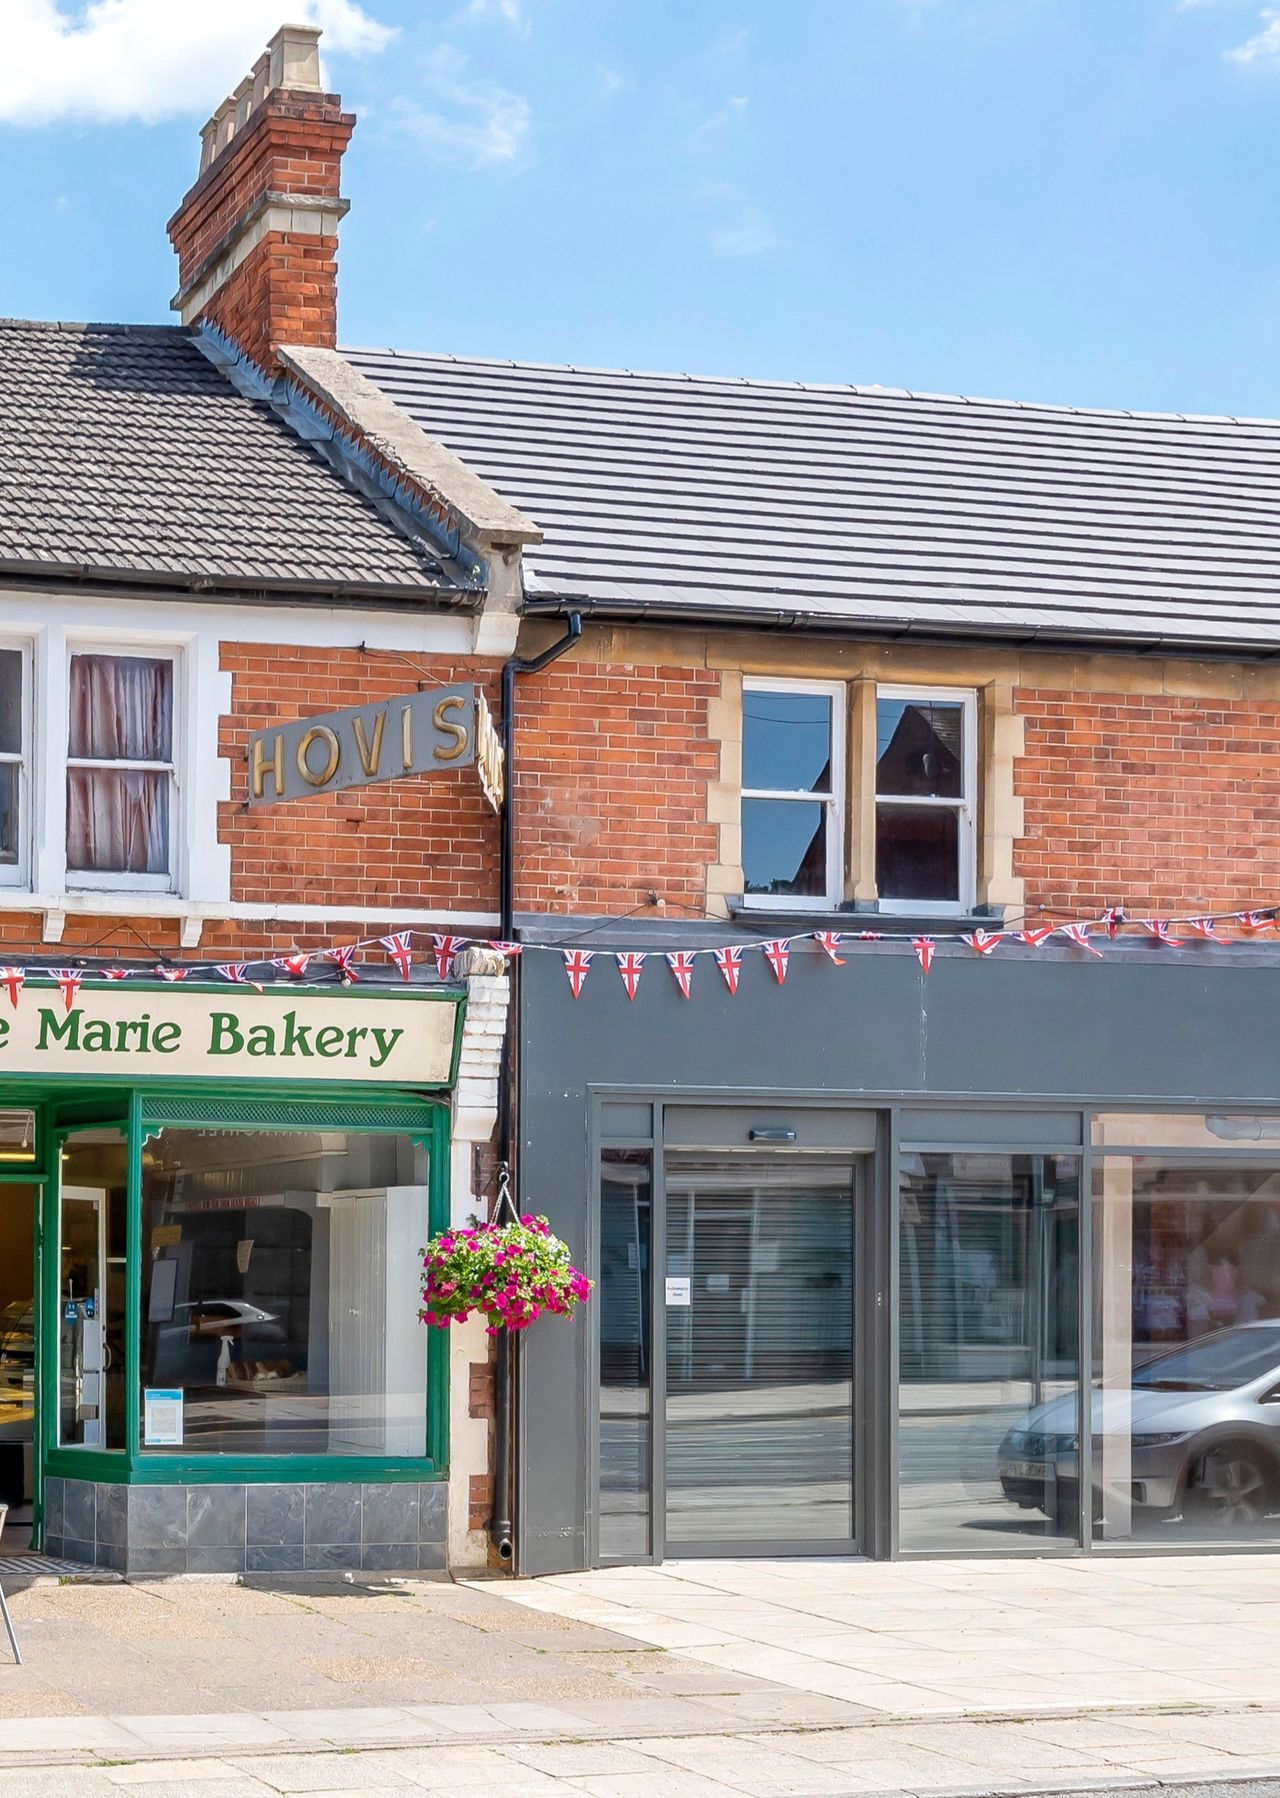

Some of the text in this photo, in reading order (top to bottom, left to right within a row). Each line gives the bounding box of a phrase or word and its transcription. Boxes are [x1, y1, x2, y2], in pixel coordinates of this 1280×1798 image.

[253, 696, 468, 798] HOVIS
[35, 1008, 182, 1053] Marie
[206, 1011, 405, 1068] Bakery
